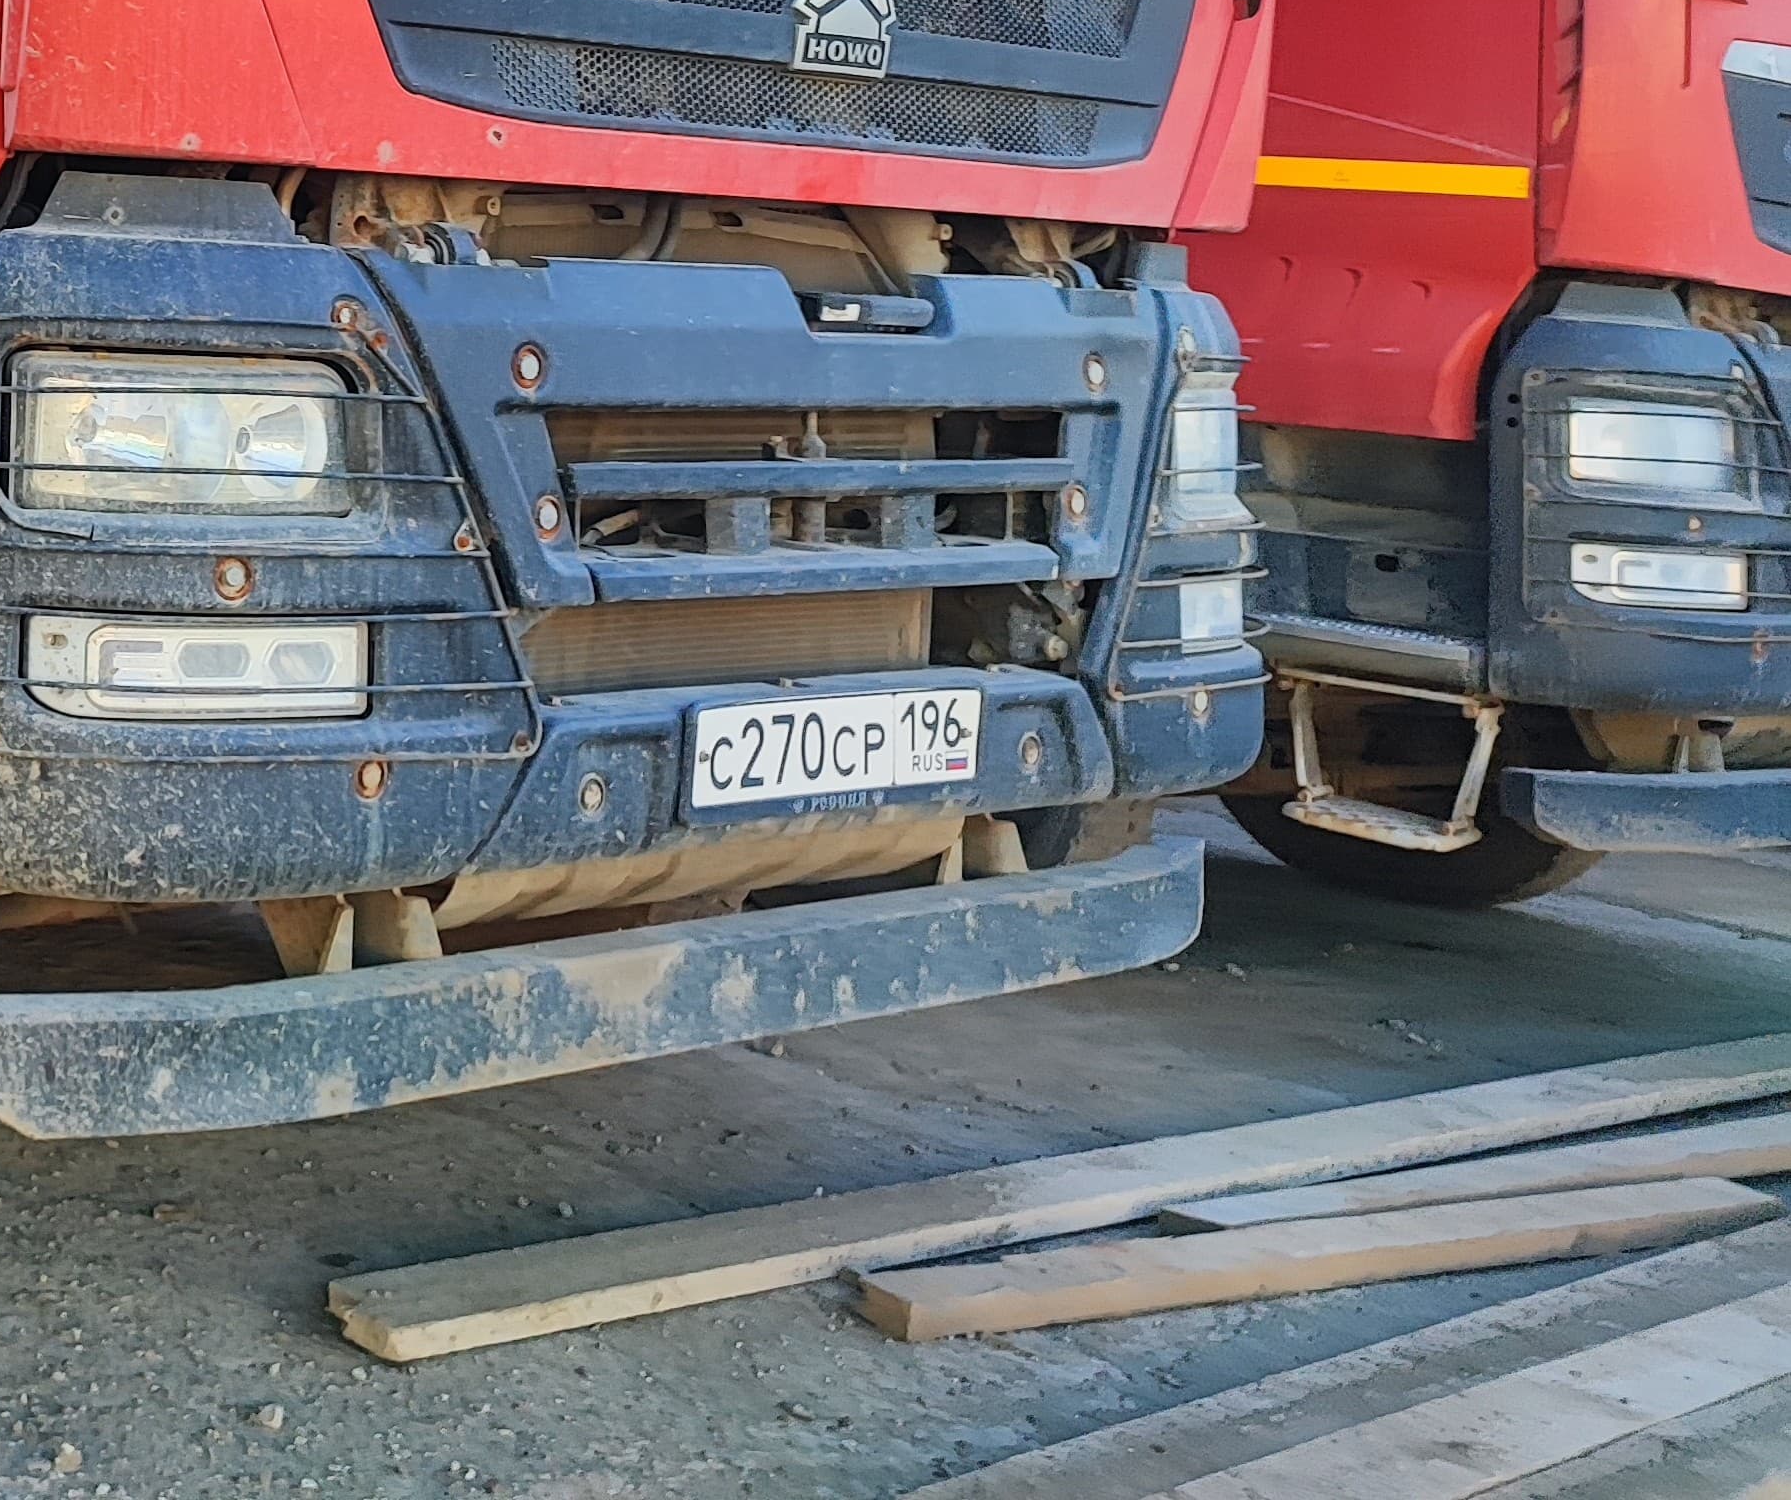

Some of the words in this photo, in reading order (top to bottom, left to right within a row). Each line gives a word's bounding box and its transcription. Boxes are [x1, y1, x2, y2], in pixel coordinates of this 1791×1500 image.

[807, 37, 883, 67] HOWO
[900, 698, 962, 753] 196
[911, 755, 944, 772] RUS
